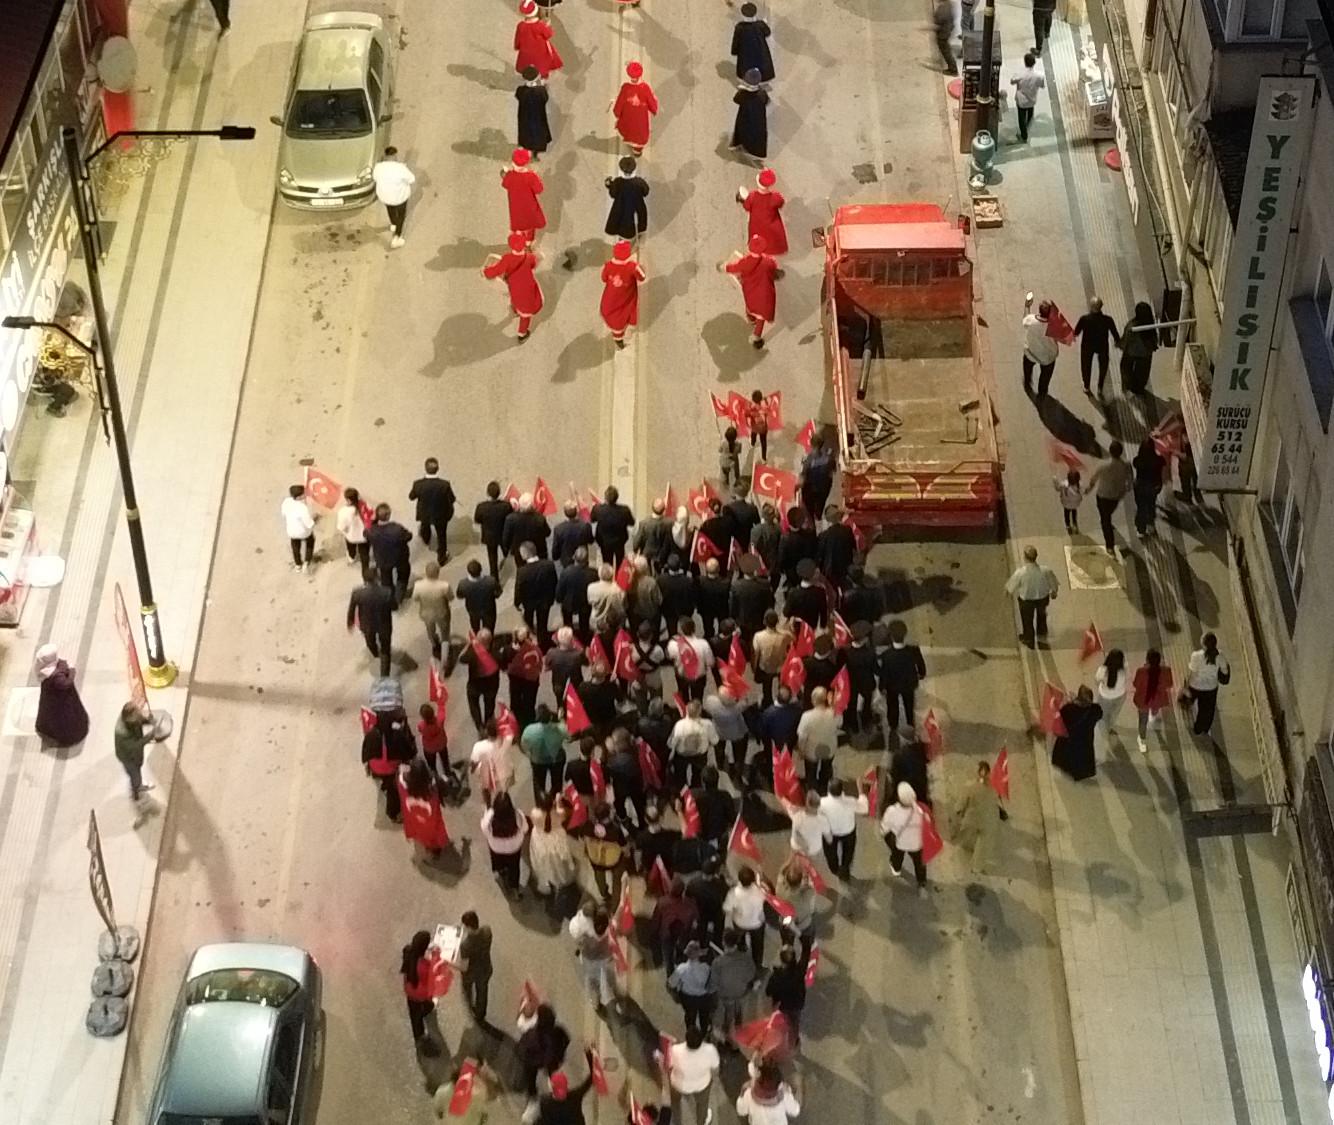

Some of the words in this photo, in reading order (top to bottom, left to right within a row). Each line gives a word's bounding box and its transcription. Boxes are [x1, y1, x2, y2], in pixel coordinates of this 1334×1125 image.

[1216, 419, 1248, 429] KURSU
[1216, 432, 1243, 442] 512
[1211, 444, 1225, 454] 65
[1228, 444, 1243, 454] 44
[1221, 455, 1238, 464] 544
